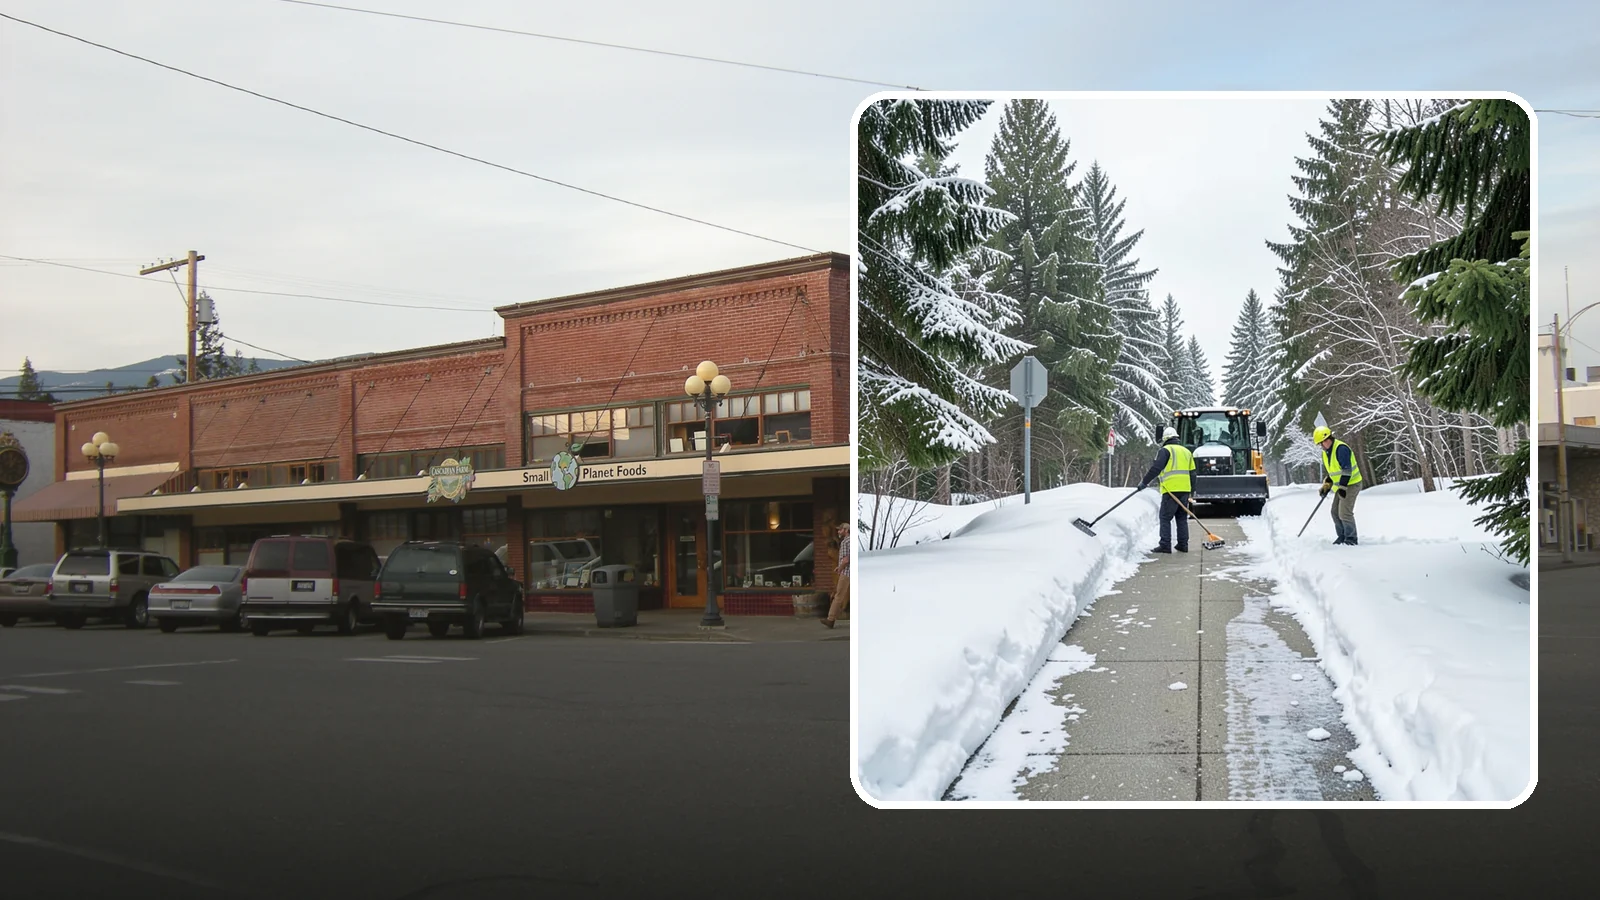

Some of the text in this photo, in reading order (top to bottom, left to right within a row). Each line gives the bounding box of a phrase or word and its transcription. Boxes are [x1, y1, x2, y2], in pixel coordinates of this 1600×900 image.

[456, 466, 469, 475] FARM
[523, 464, 647, 483] Small Planet Foods
